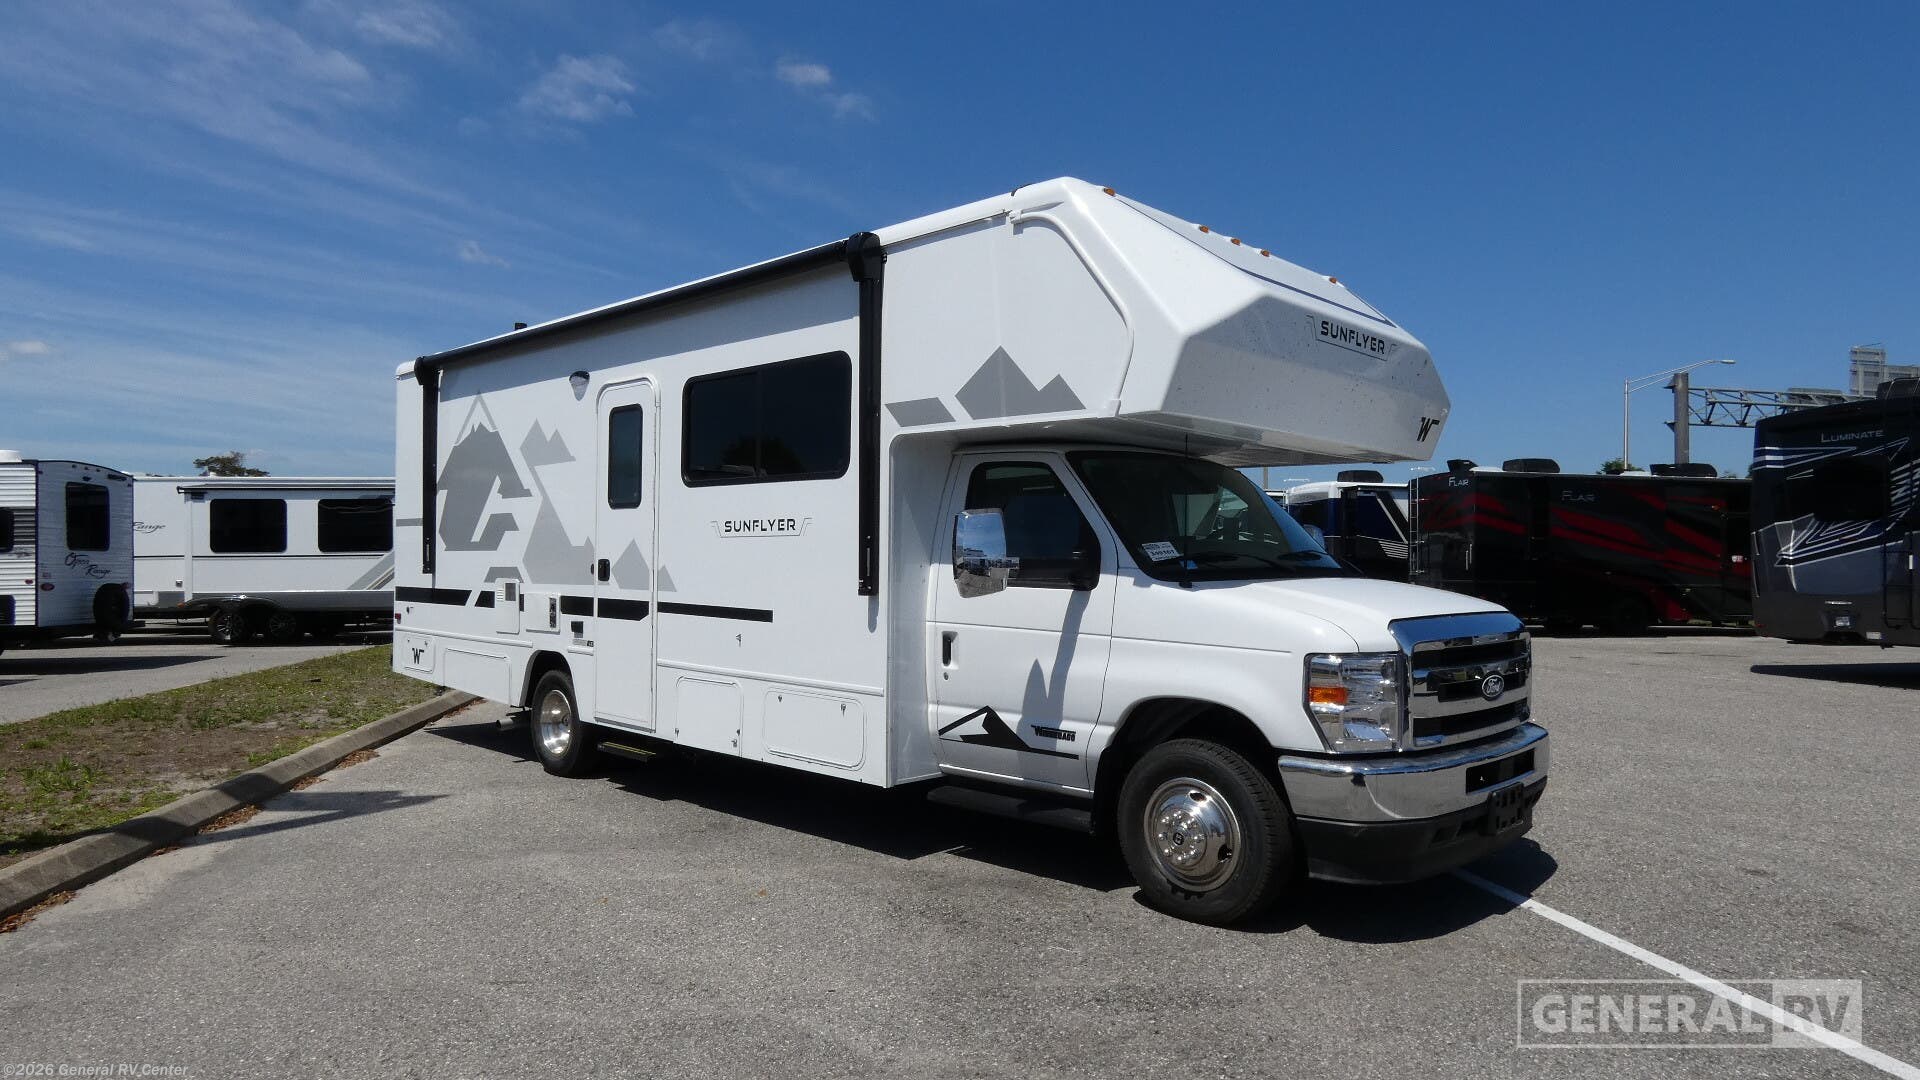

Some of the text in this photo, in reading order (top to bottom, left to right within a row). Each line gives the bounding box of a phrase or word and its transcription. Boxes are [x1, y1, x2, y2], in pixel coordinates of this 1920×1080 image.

[1320, 320, 1386, 355] SUNFLYER
[1820, 428, 1885, 443] LUMINATE
[1448, 476, 1468, 487] FLAIR
[724, 518, 797, 536] SUNFLYER
